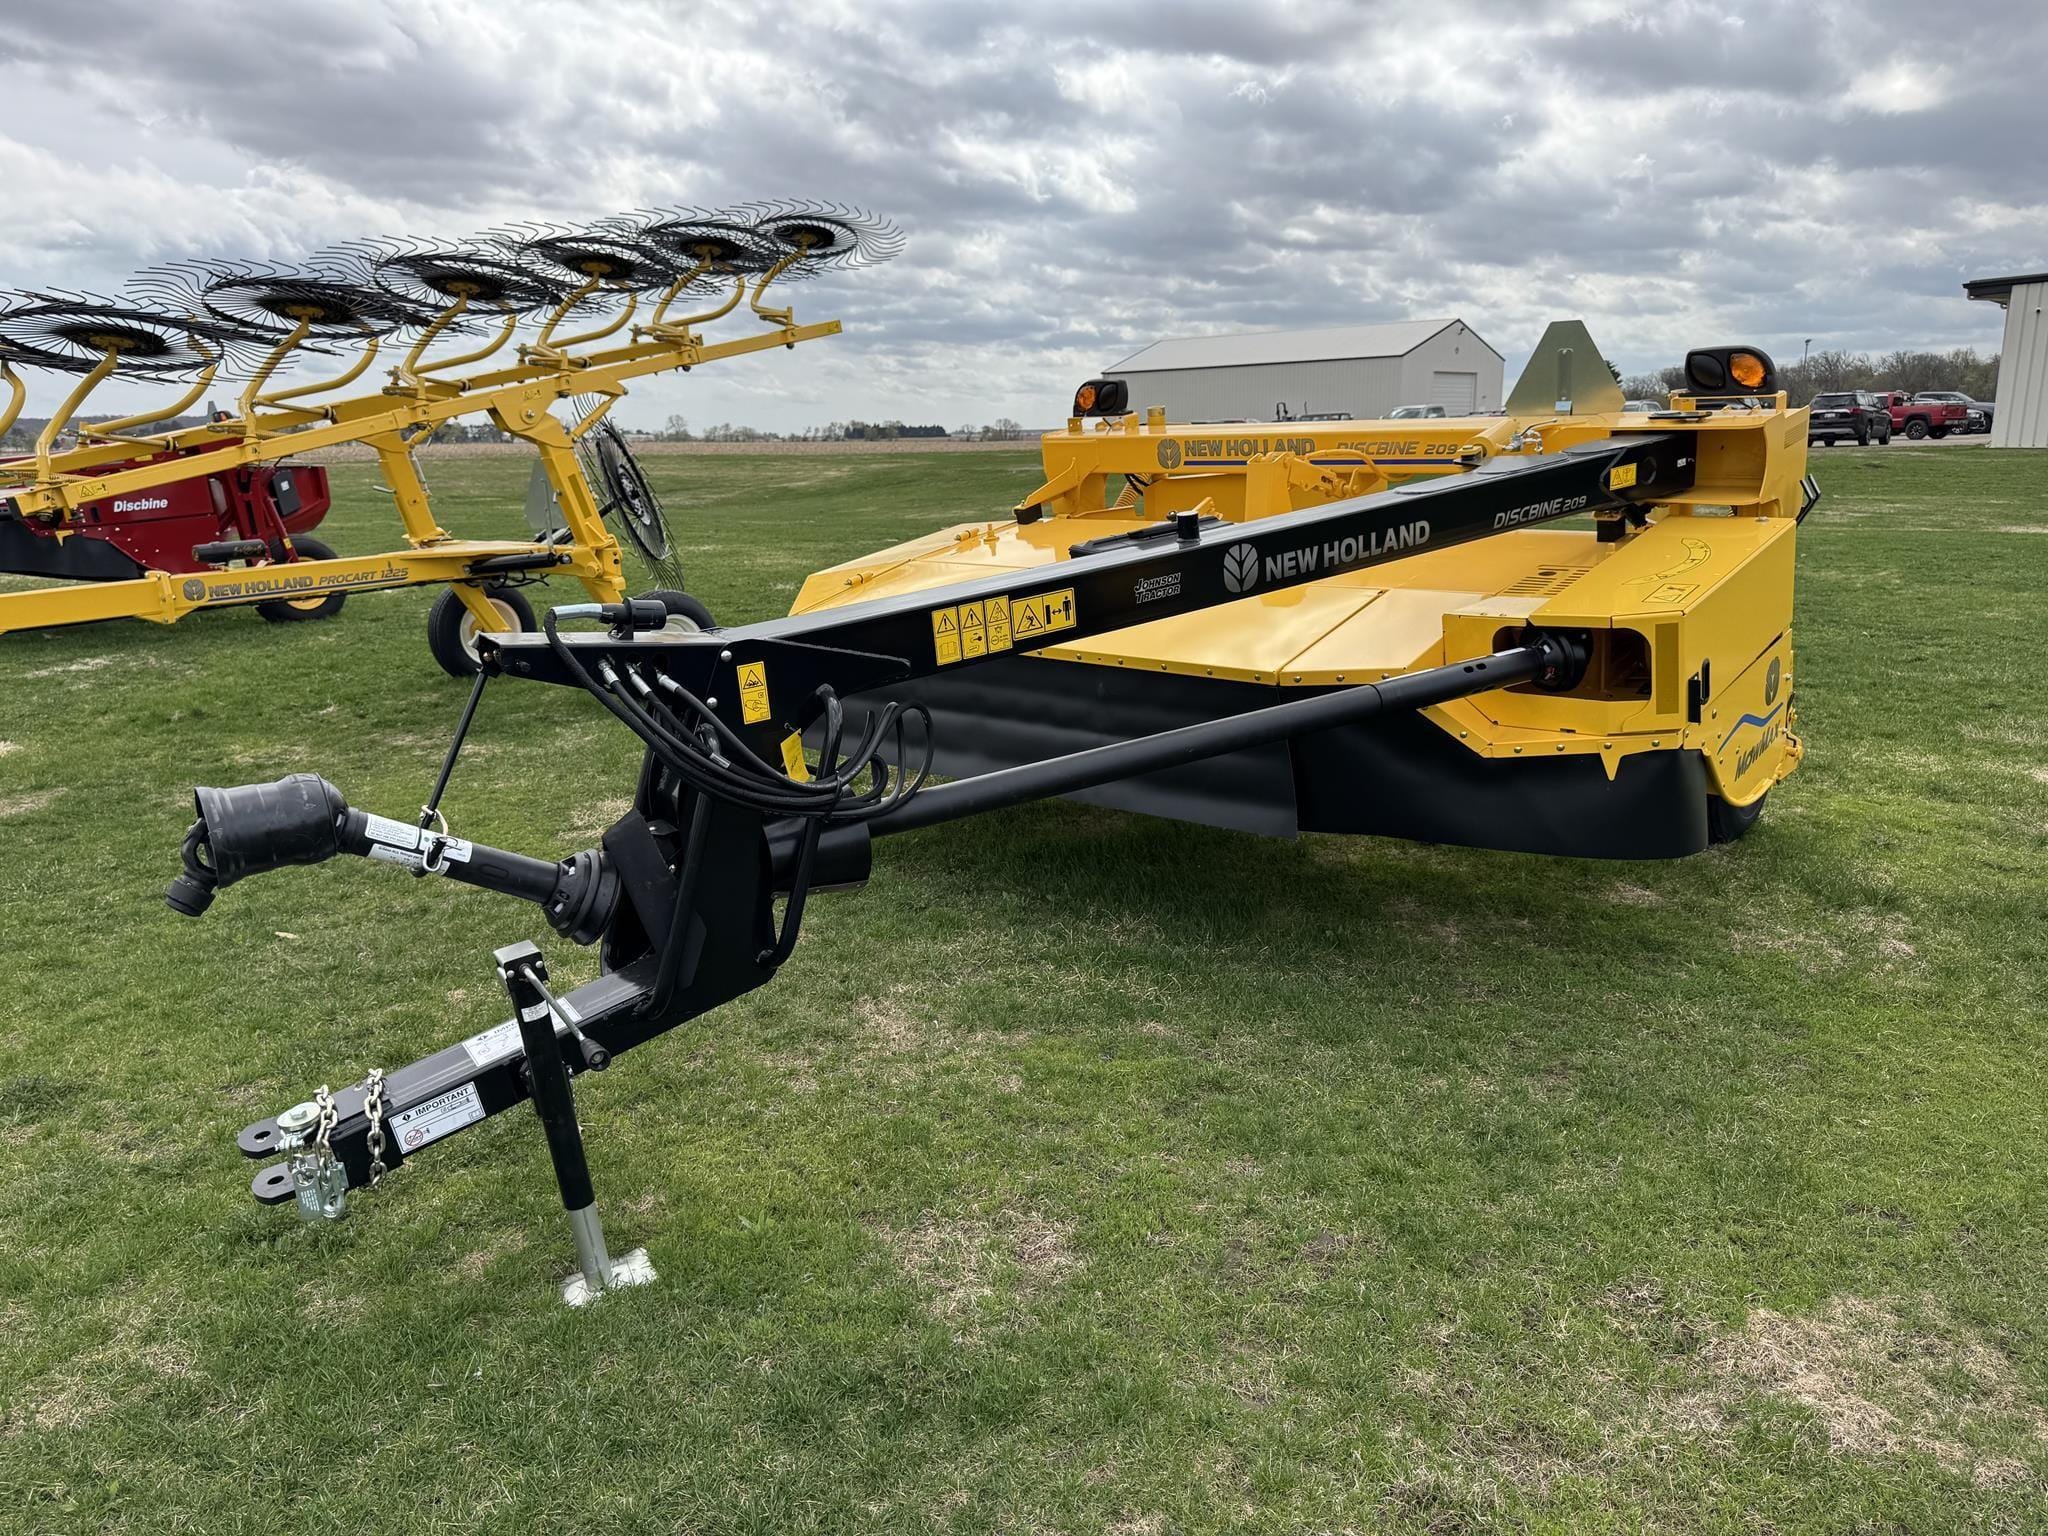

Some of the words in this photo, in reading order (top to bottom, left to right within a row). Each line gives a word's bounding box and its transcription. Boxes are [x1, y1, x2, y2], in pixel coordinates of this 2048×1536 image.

[1184, 439, 1222, 457] NEW
[1226, 438, 1315, 456] HOLLAND
[1424, 443, 1458, 455] 209
[114, 497, 168, 513] Discbine
[1493, 498, 1564, 529] DISCBINE
[1562, 495, 1587, 512] 209
[1265, 545, 1319, 582] NEW
[1324, 520, 1431, 568] HOLLAND
[208, 583, 242, 597] NEW
[244, 575, 313, 593] HOLLAND
[319, 570, 377, 586] PROCART
[380, 567, 409, 579] 1225
[1134, 572, 1181, 594] JOHNSON
[1135, 584, 1181, 604] TRACTOR
[415, 1088, 469, 1116] IMPORTANT
